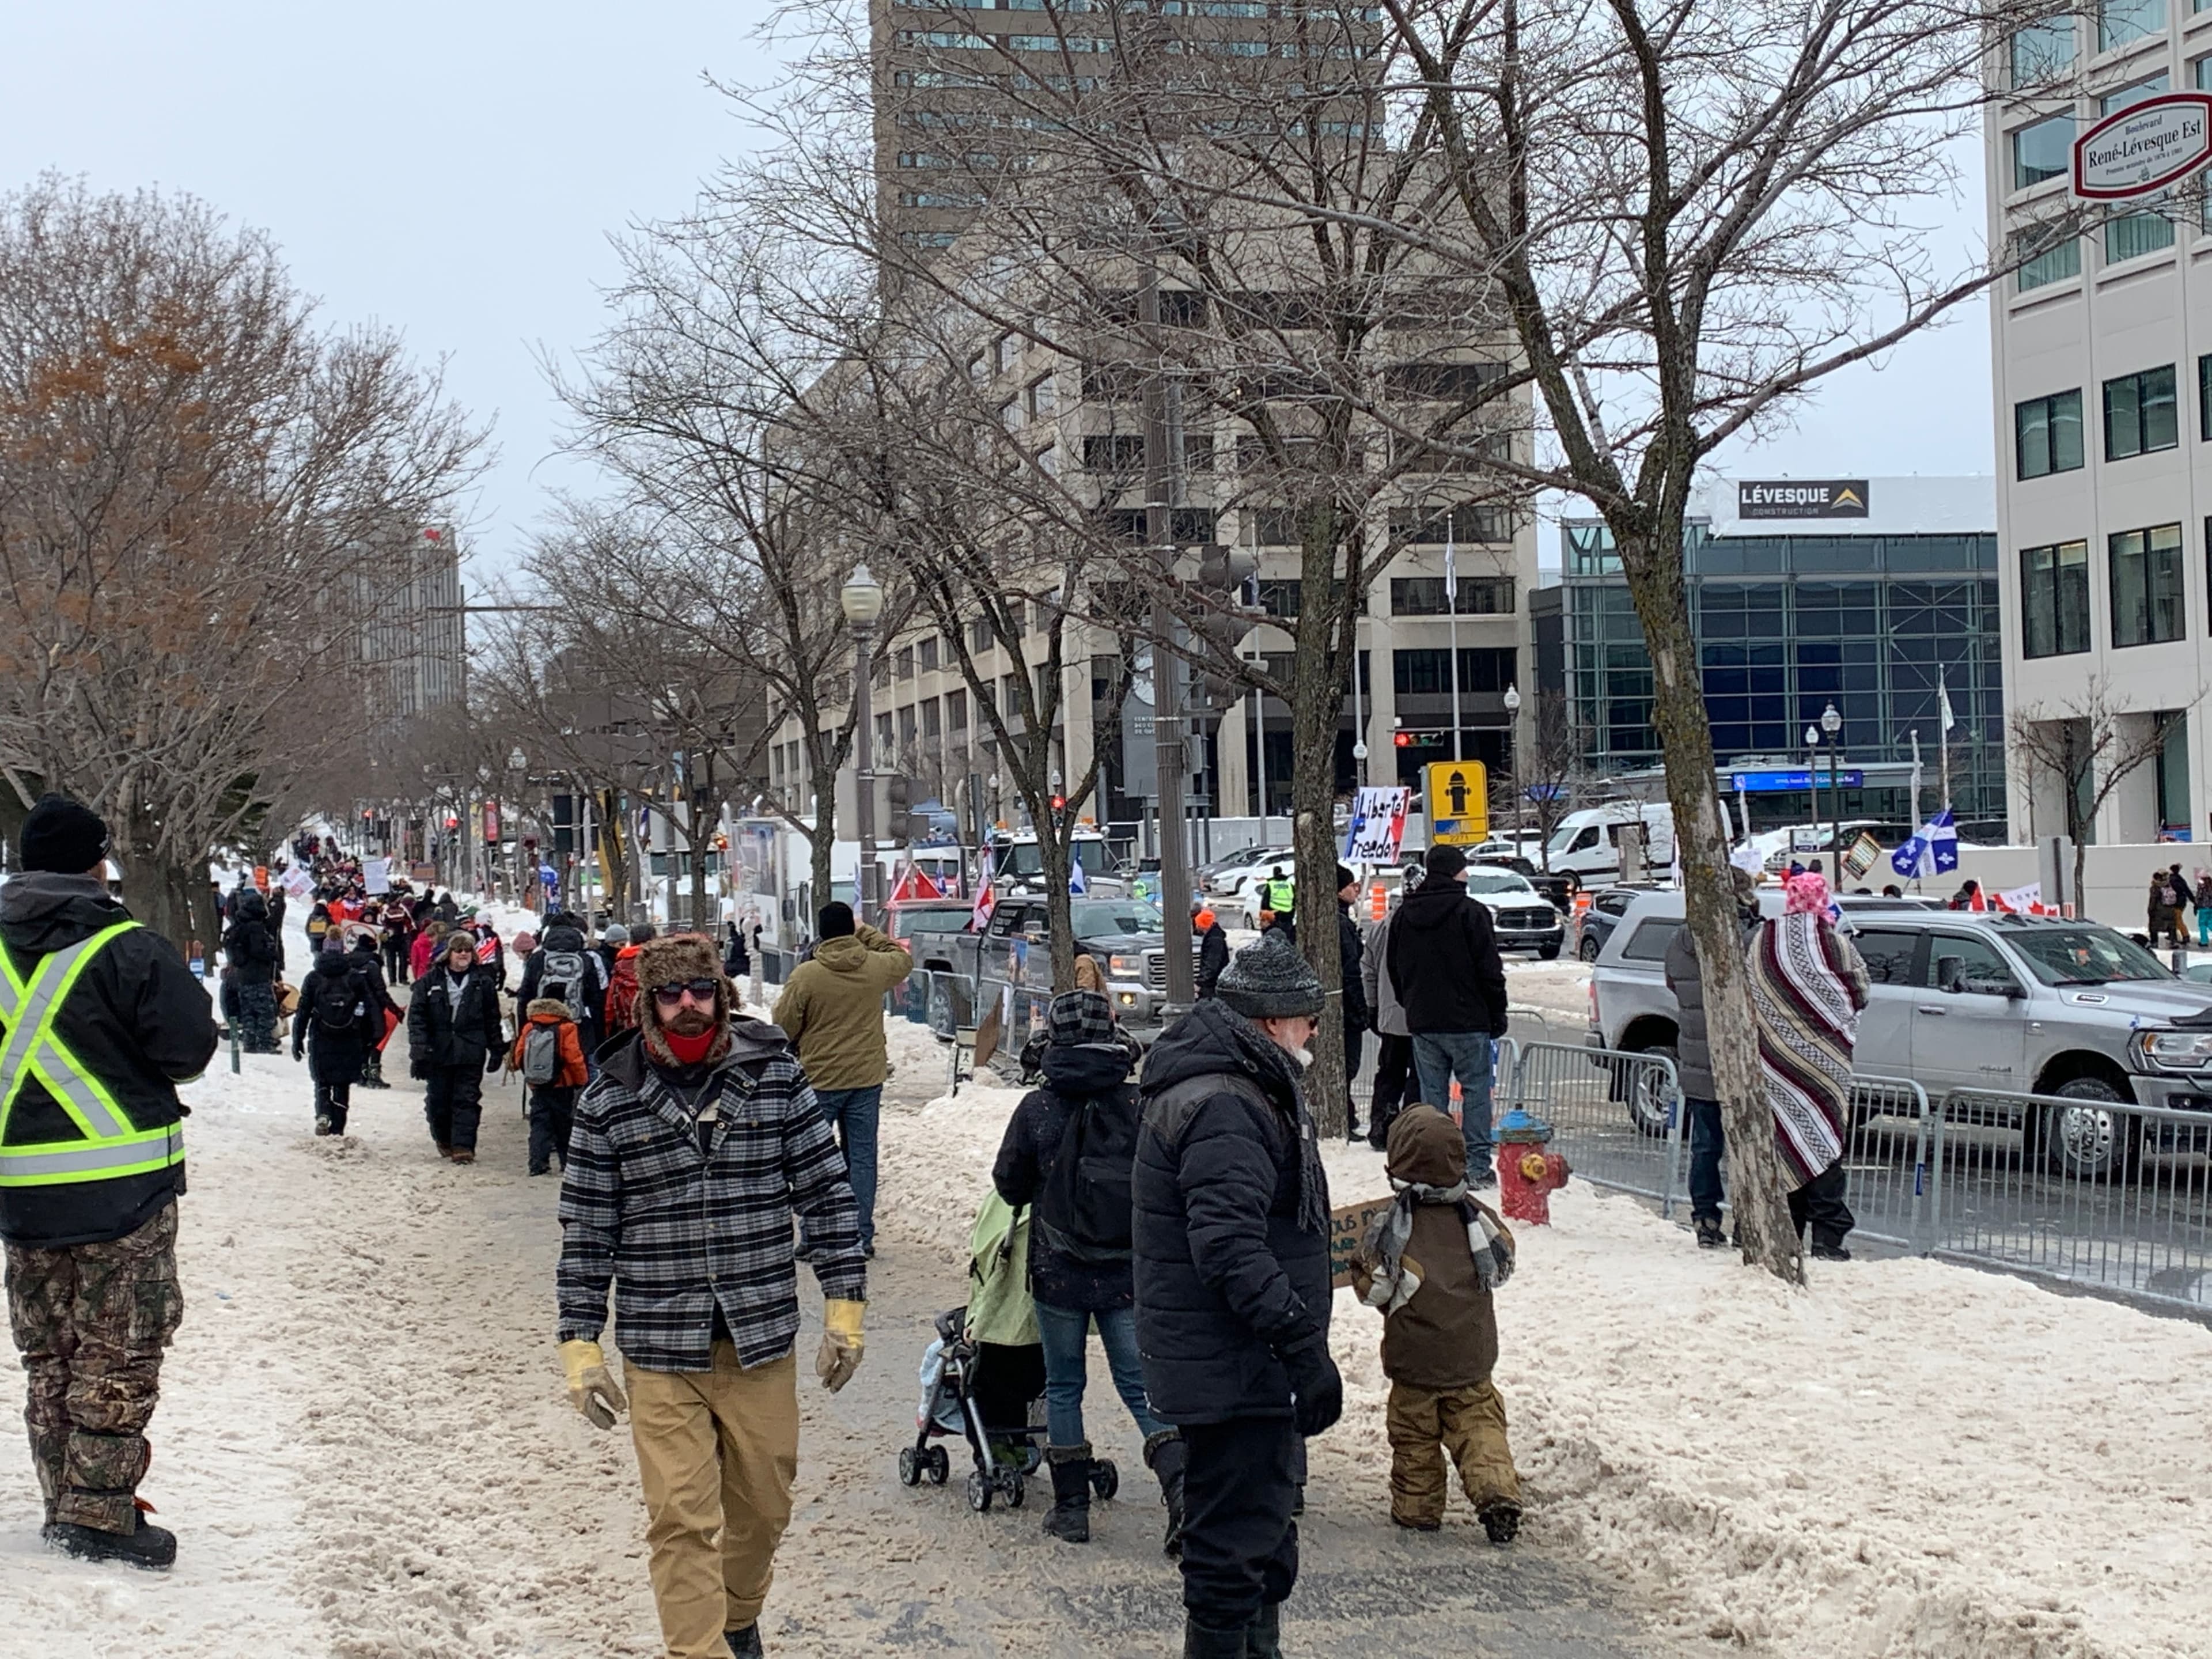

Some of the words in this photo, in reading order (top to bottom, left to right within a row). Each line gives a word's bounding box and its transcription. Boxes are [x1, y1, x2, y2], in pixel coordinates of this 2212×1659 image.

[2125, 115, 2162, 135] Boulevard
[2088, 127, 2179, 168] René-Lévesque
[2182, 118, 2202, 139] Est
[1741, 484, 1829, 505] LÉVESQUE
[1752, 506, 1819, 516] CONSTRUCTION
